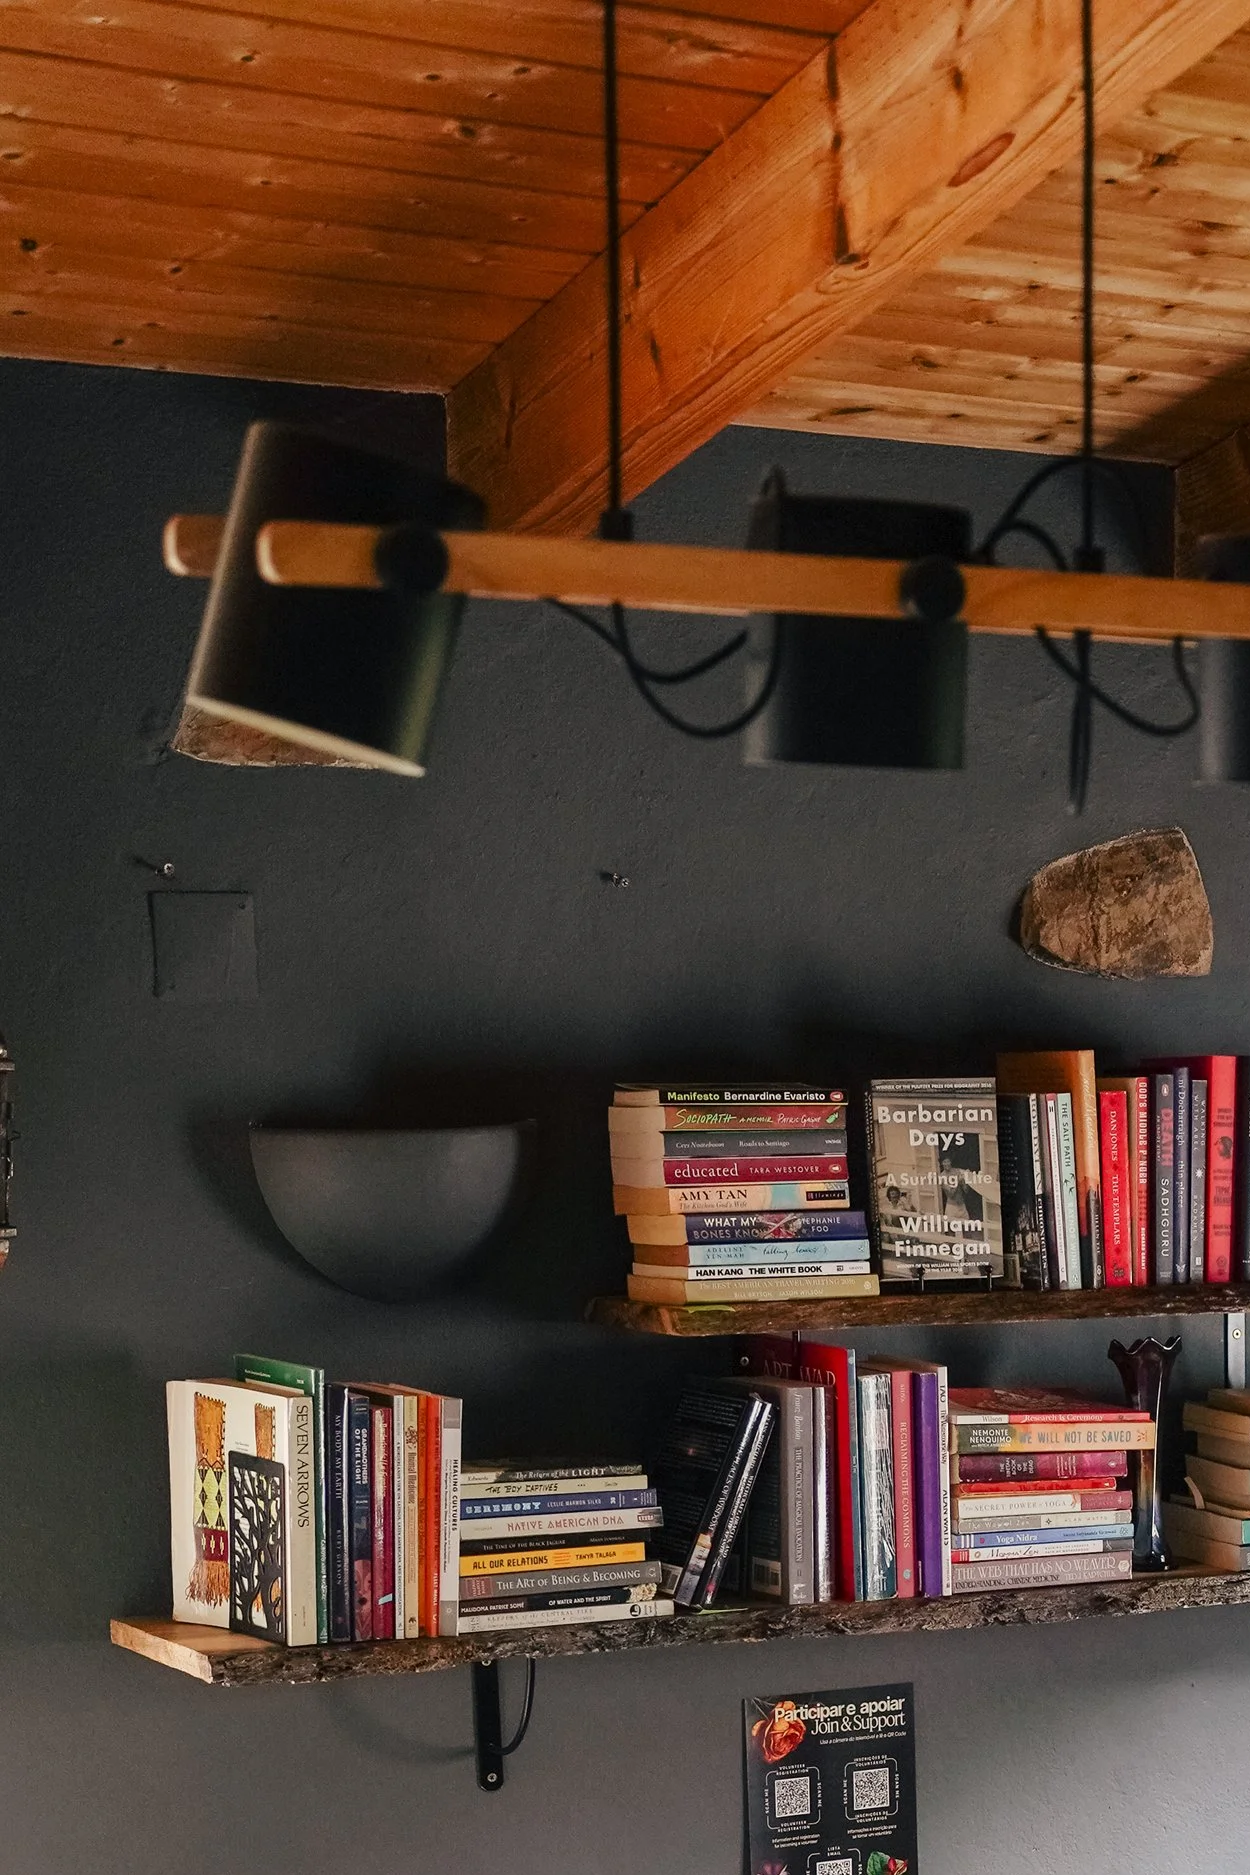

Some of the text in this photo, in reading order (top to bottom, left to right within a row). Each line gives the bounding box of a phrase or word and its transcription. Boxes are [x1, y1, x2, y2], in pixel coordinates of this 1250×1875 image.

[667, 1091, 720, 1101] Manifesto
[724, 1091, 826, 1101] Bernardine Evaristo
[877, 1104, 993, 1124] Barbarian
[1138, 1082, 1147, 1146] GOD'S MIDDLE
[909, 1129, 965, 1151] Days
[1110, 1110, 1118, 1162] DAN JONES
[674, 1163, 739, 1178] educated
[750, 1166, 820, 1174] TARA WESTOVER
[885, 1171, 993, 1188] A Surfing Life
[679, 1189, 748, 1202] AMY TAN
[704, 1217, 758, 1228] WHAT MY
[899, 1214, 982, 1233] William
[1112, 1196, 1120, 1245] TEMPLARS
[1161, 1178, 1170, 1258] SADHGURU
[693, 1230, 732, 1240] BONES
[895, 1240, 991, 1260] Finnegan
[696, 1268, 744, 1278] HAN KANG
[748, 1266, 823, 1276] THE WHITE BOOK
[1024, 1414, 1058, 1424] Research
[1066, 1414, 1104, 1422] Ceremony
[355, 1428, 360, 1440] OF
[970, 1436, 1012, 1444] NENQUIMO
[1018, 1432, 1032, 1444] WE
[1038, 1432, 1060, 1444] WILL
[1064, 1431, 1082, 1444] NOT
[1086, 1430, 1098, 1442] BE
[1102, 1430, 1132, 1442] SAVED
[900, 1422, 908, 1478] RECLAIMING
[297, 1405, 310, 1528] SEVEN ARROWS
[465, 1502, 542, 1514] CEREMONY
[588, 1498, 602, 1506] SILKO
[508, 1516, 624, 1532] NATIVE AMERICAN DNA
[902, 1497, 911, 1548] COMMONS
[996, 1533, 1038, 1544] Yoga Nidra
[596, 1551, 616, 1559] TALAGA
[472, 1556, 548, 1570] ALL OUR RELATIONS
[955, 1556, 1116, 1580] THE WEB THAT HAS NO WEAVER
[496, 1580, 514, 1590] THE
[516, 1577, 536, 1589] ART
[537, 1578, 548, 1587] OF
[552, 1574, 580, 1586] BEING
[583, 1574, 590, 1583] &
[593, 1570, 641, 1582] BECOMING
[774, 1696, 906, 1723] Participar e apoiar
[810, 1712, 906, 1736] Join & Support
[776, 1768, 809, 1776] REGISTRATION
[780, 1820, 807, 1828] VOLUNTEER
